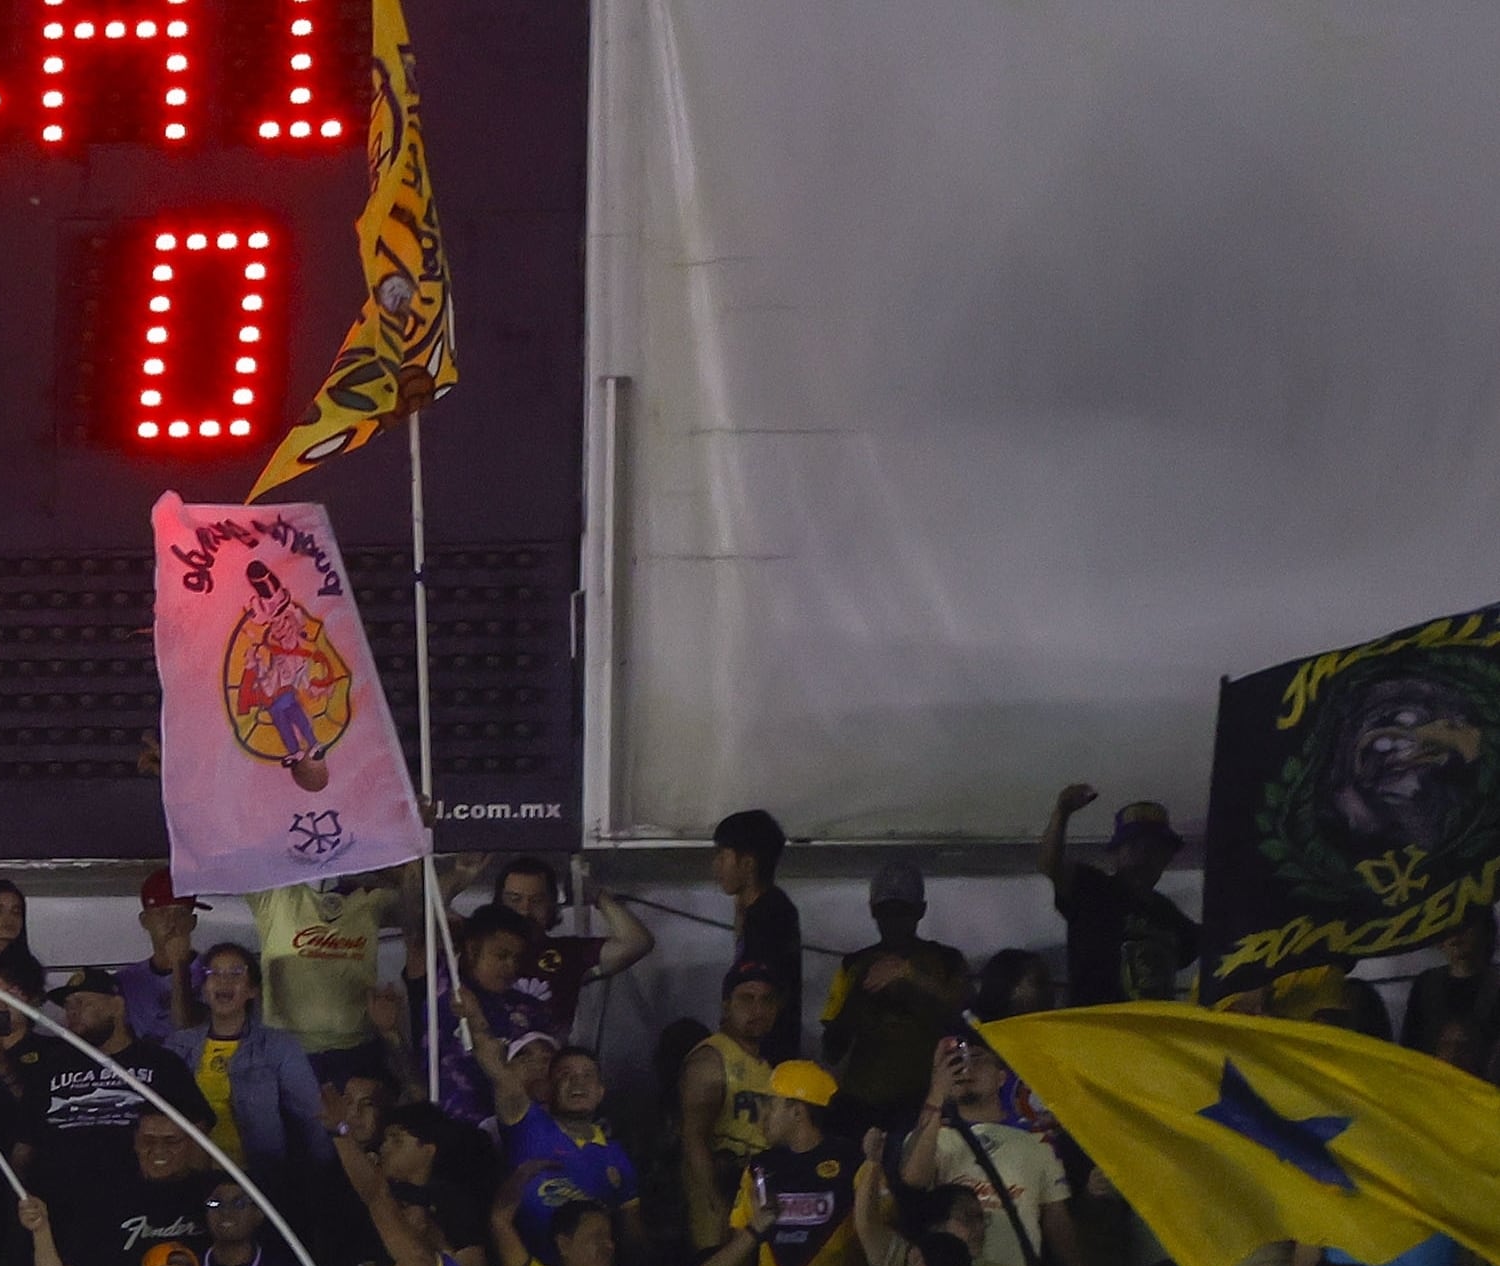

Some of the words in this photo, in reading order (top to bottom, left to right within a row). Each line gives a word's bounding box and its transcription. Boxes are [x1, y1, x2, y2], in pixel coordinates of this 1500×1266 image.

[133, 227, 279, 461] 0
[50, 1069, 96, 1092] LUCA
[119, 1215, 205, 1251] Fender
